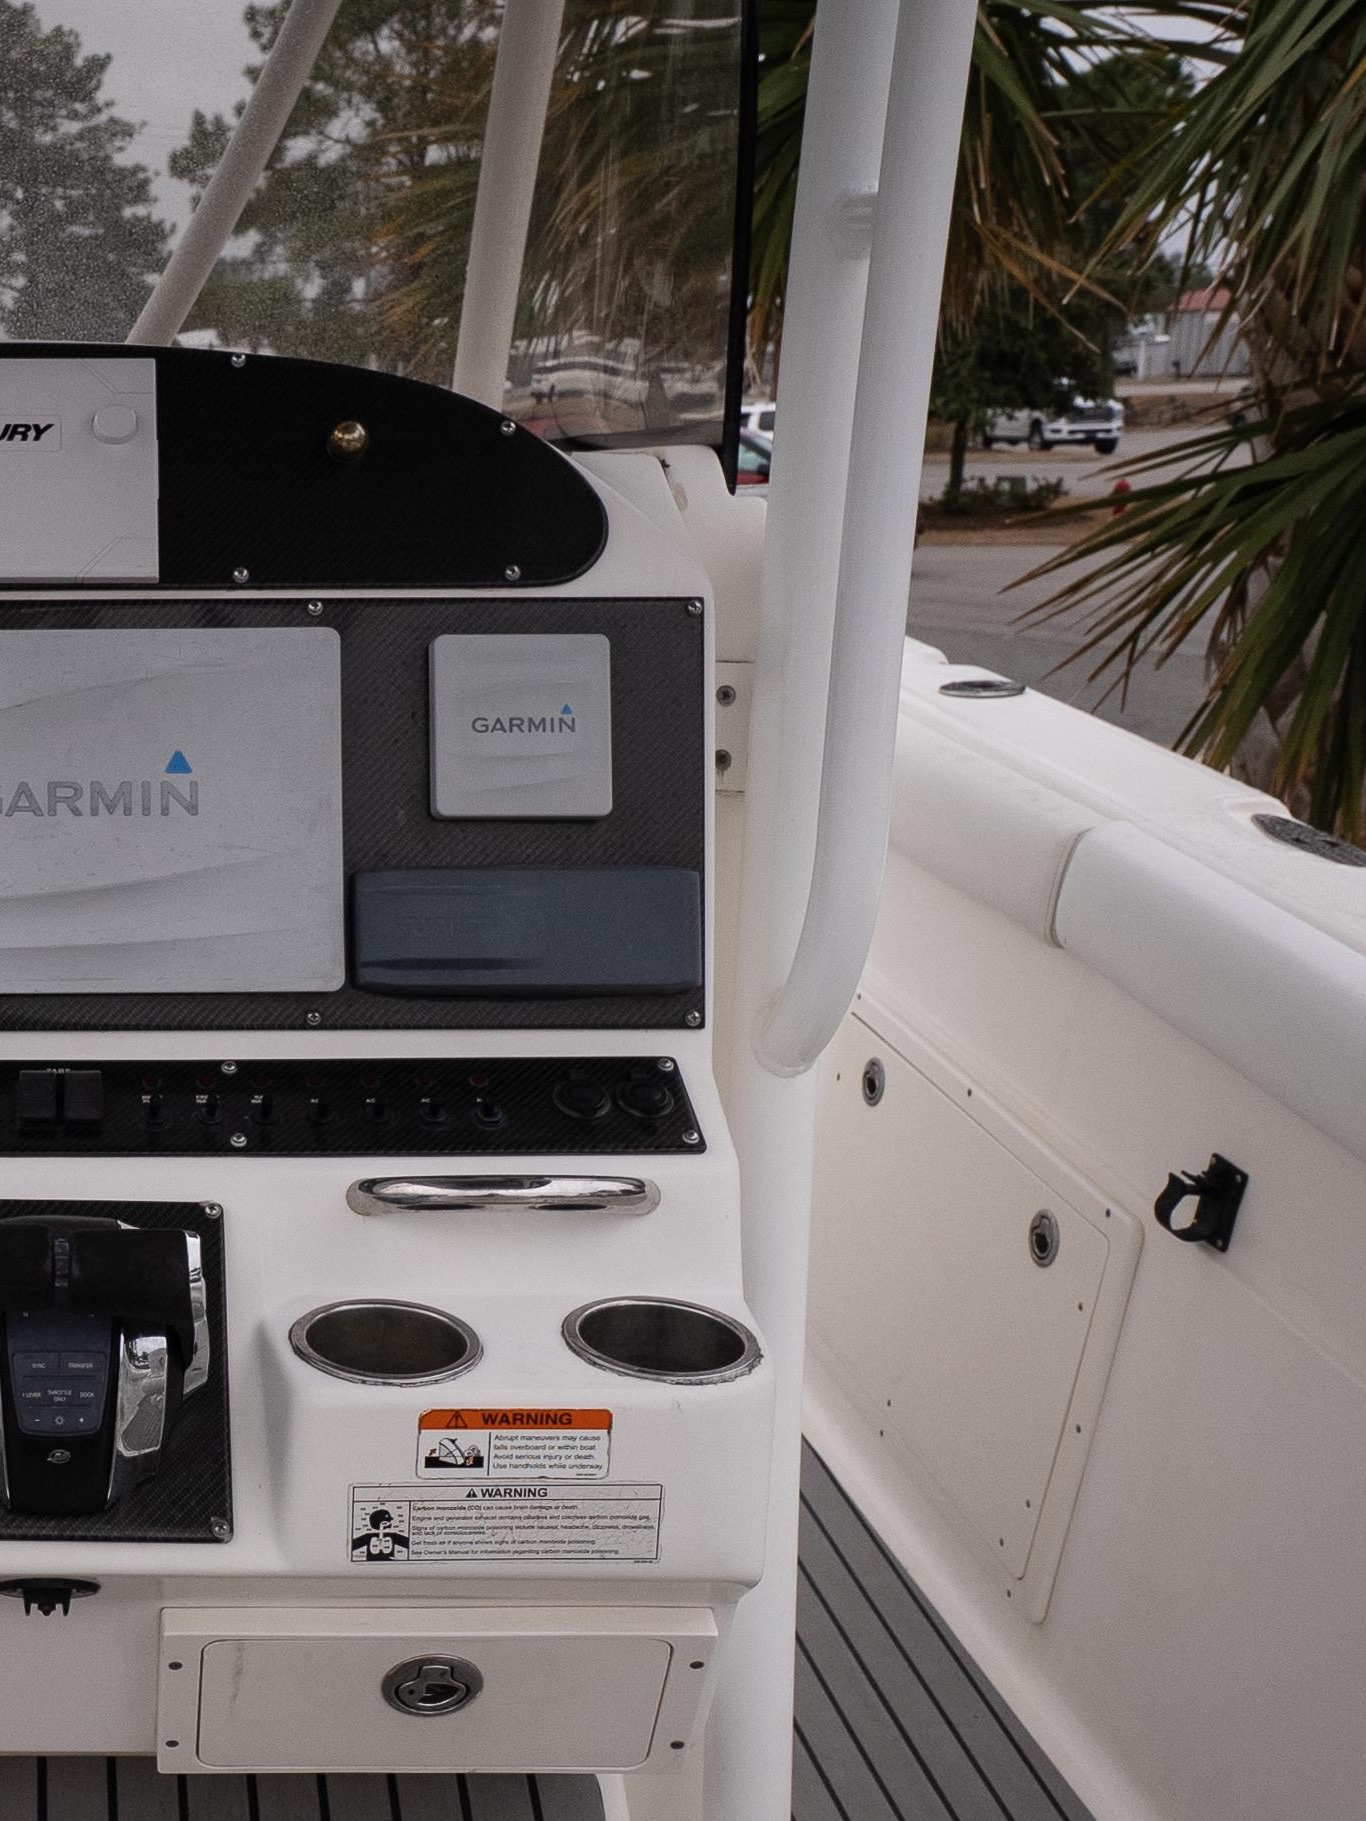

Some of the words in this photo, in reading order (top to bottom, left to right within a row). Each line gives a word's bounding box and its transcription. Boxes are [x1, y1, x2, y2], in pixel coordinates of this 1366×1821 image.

[471, 716, 576, 734] GARMIN
[482, 1413, 572, 1425] WARNING
[480, 1488, 548, 1498] WARNING
